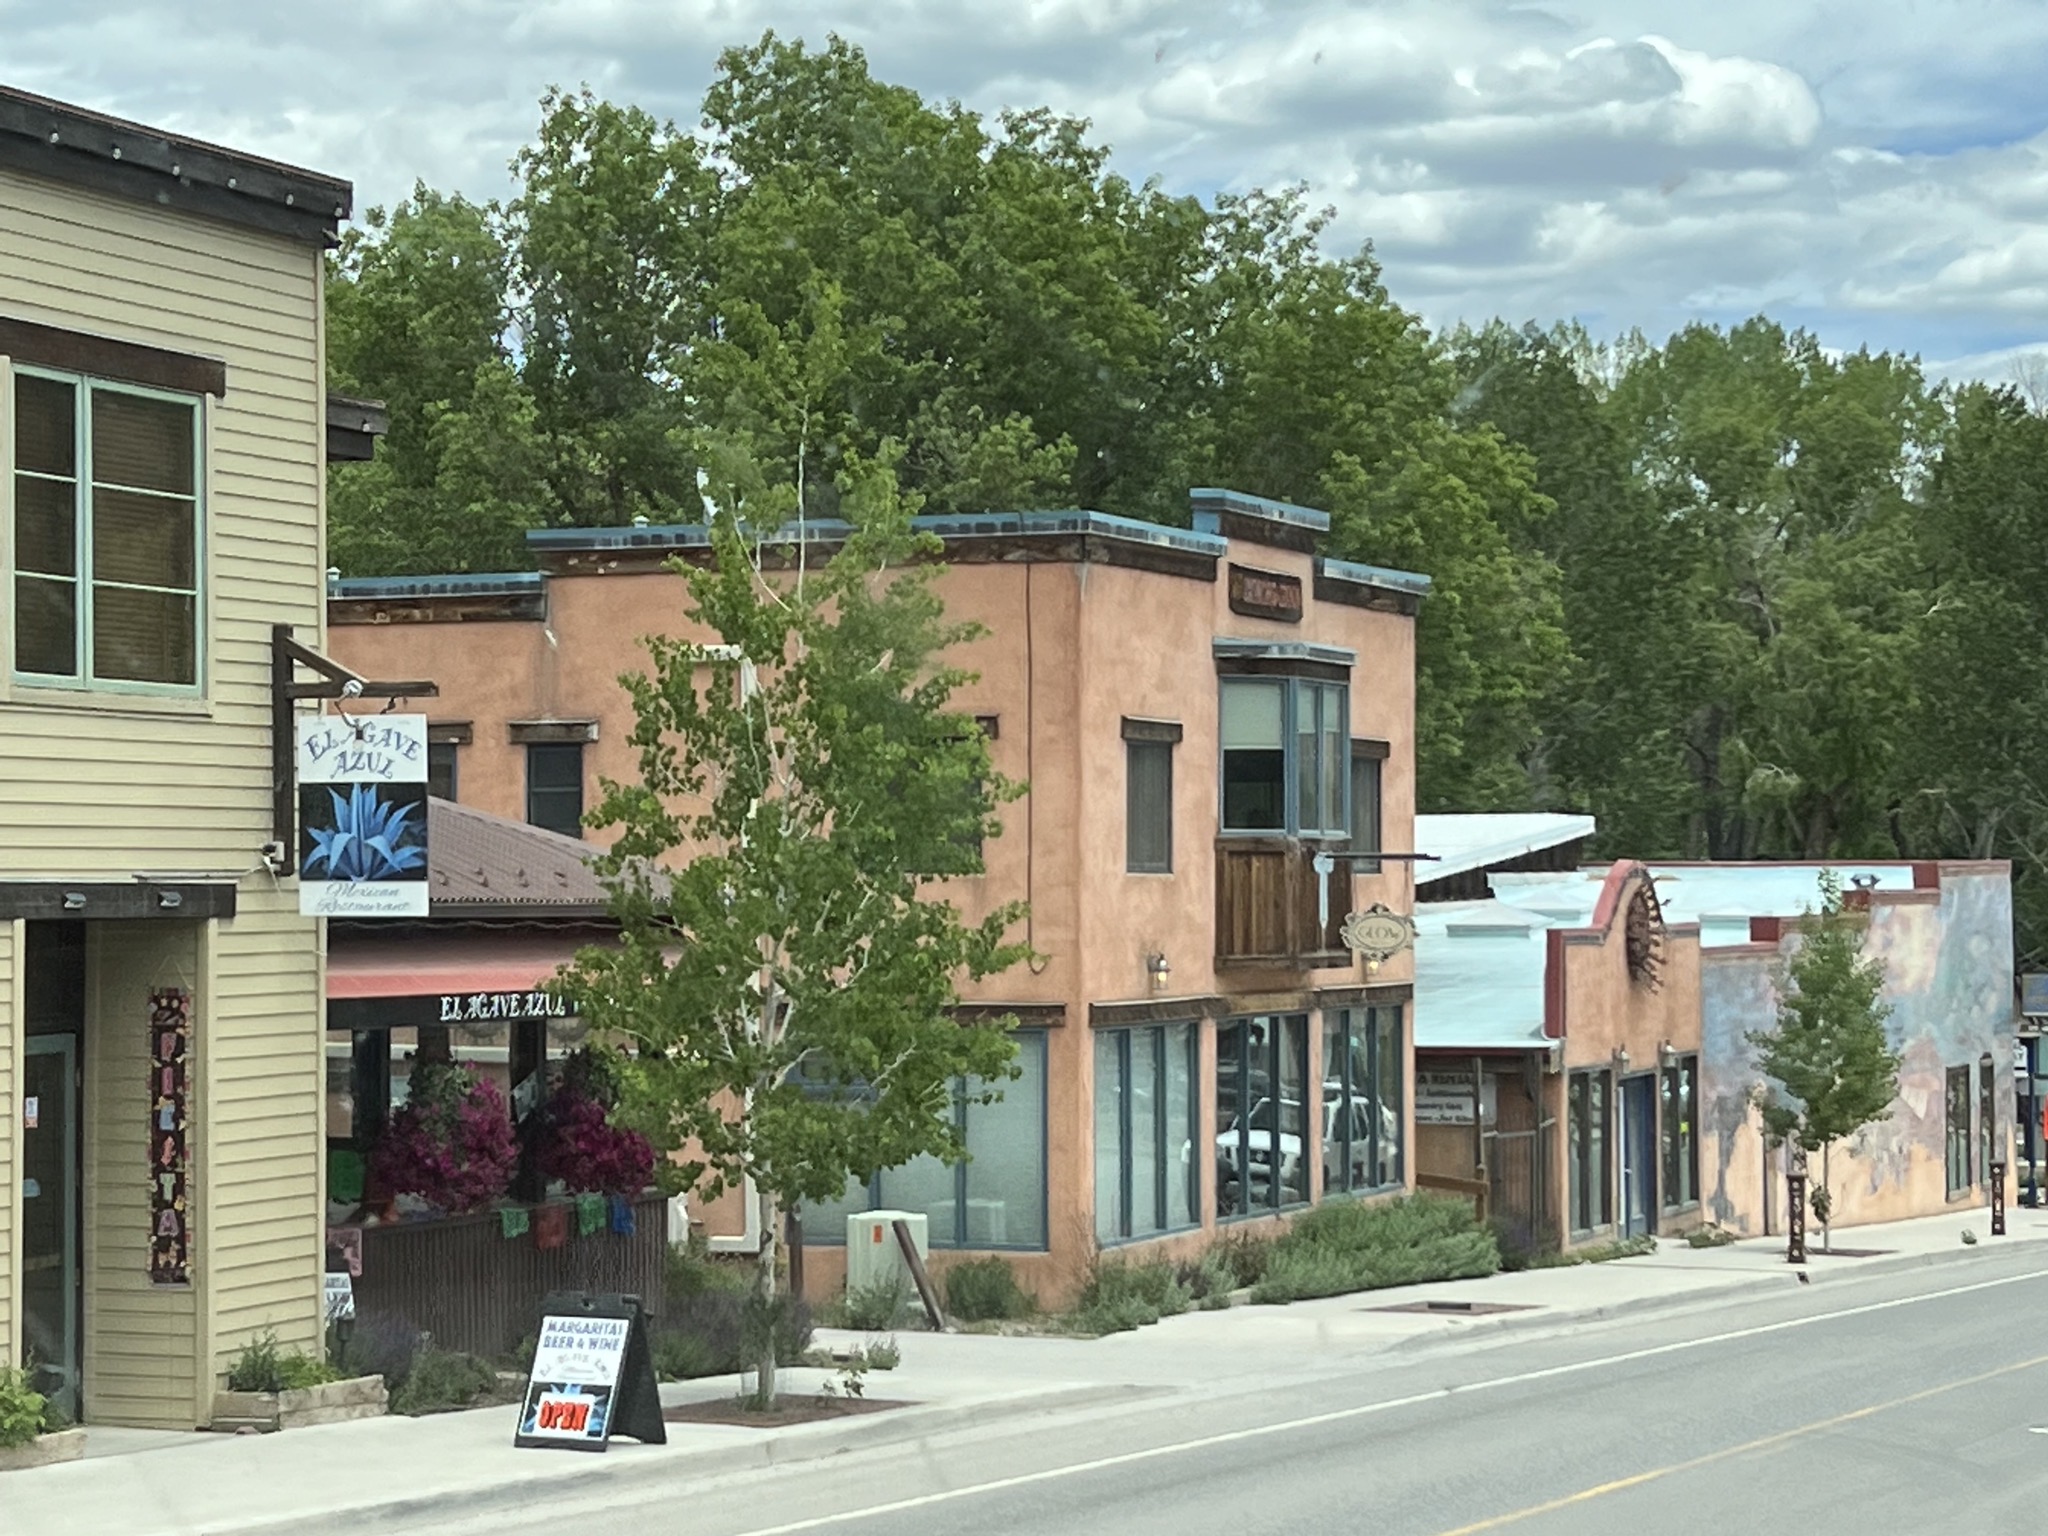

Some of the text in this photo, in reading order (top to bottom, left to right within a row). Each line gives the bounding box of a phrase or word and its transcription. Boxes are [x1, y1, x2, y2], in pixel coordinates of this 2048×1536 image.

[303, 728, 339, 763] EL
[330, 751, 395, 779] AZUL
[325, 883, 400, 898] Mexican
[315, 897, 410, 913] Restaurant
[440, 996, 462, 1021] EL
[464, 993, 520, 1019] AGAVE
[521, 992, 566, 1016] AZUL
[543, 1335, 575, 1350] BEER
[588, 1337, 620, 1351] WINE
[539, 1400, 590, 1431] OPEN
